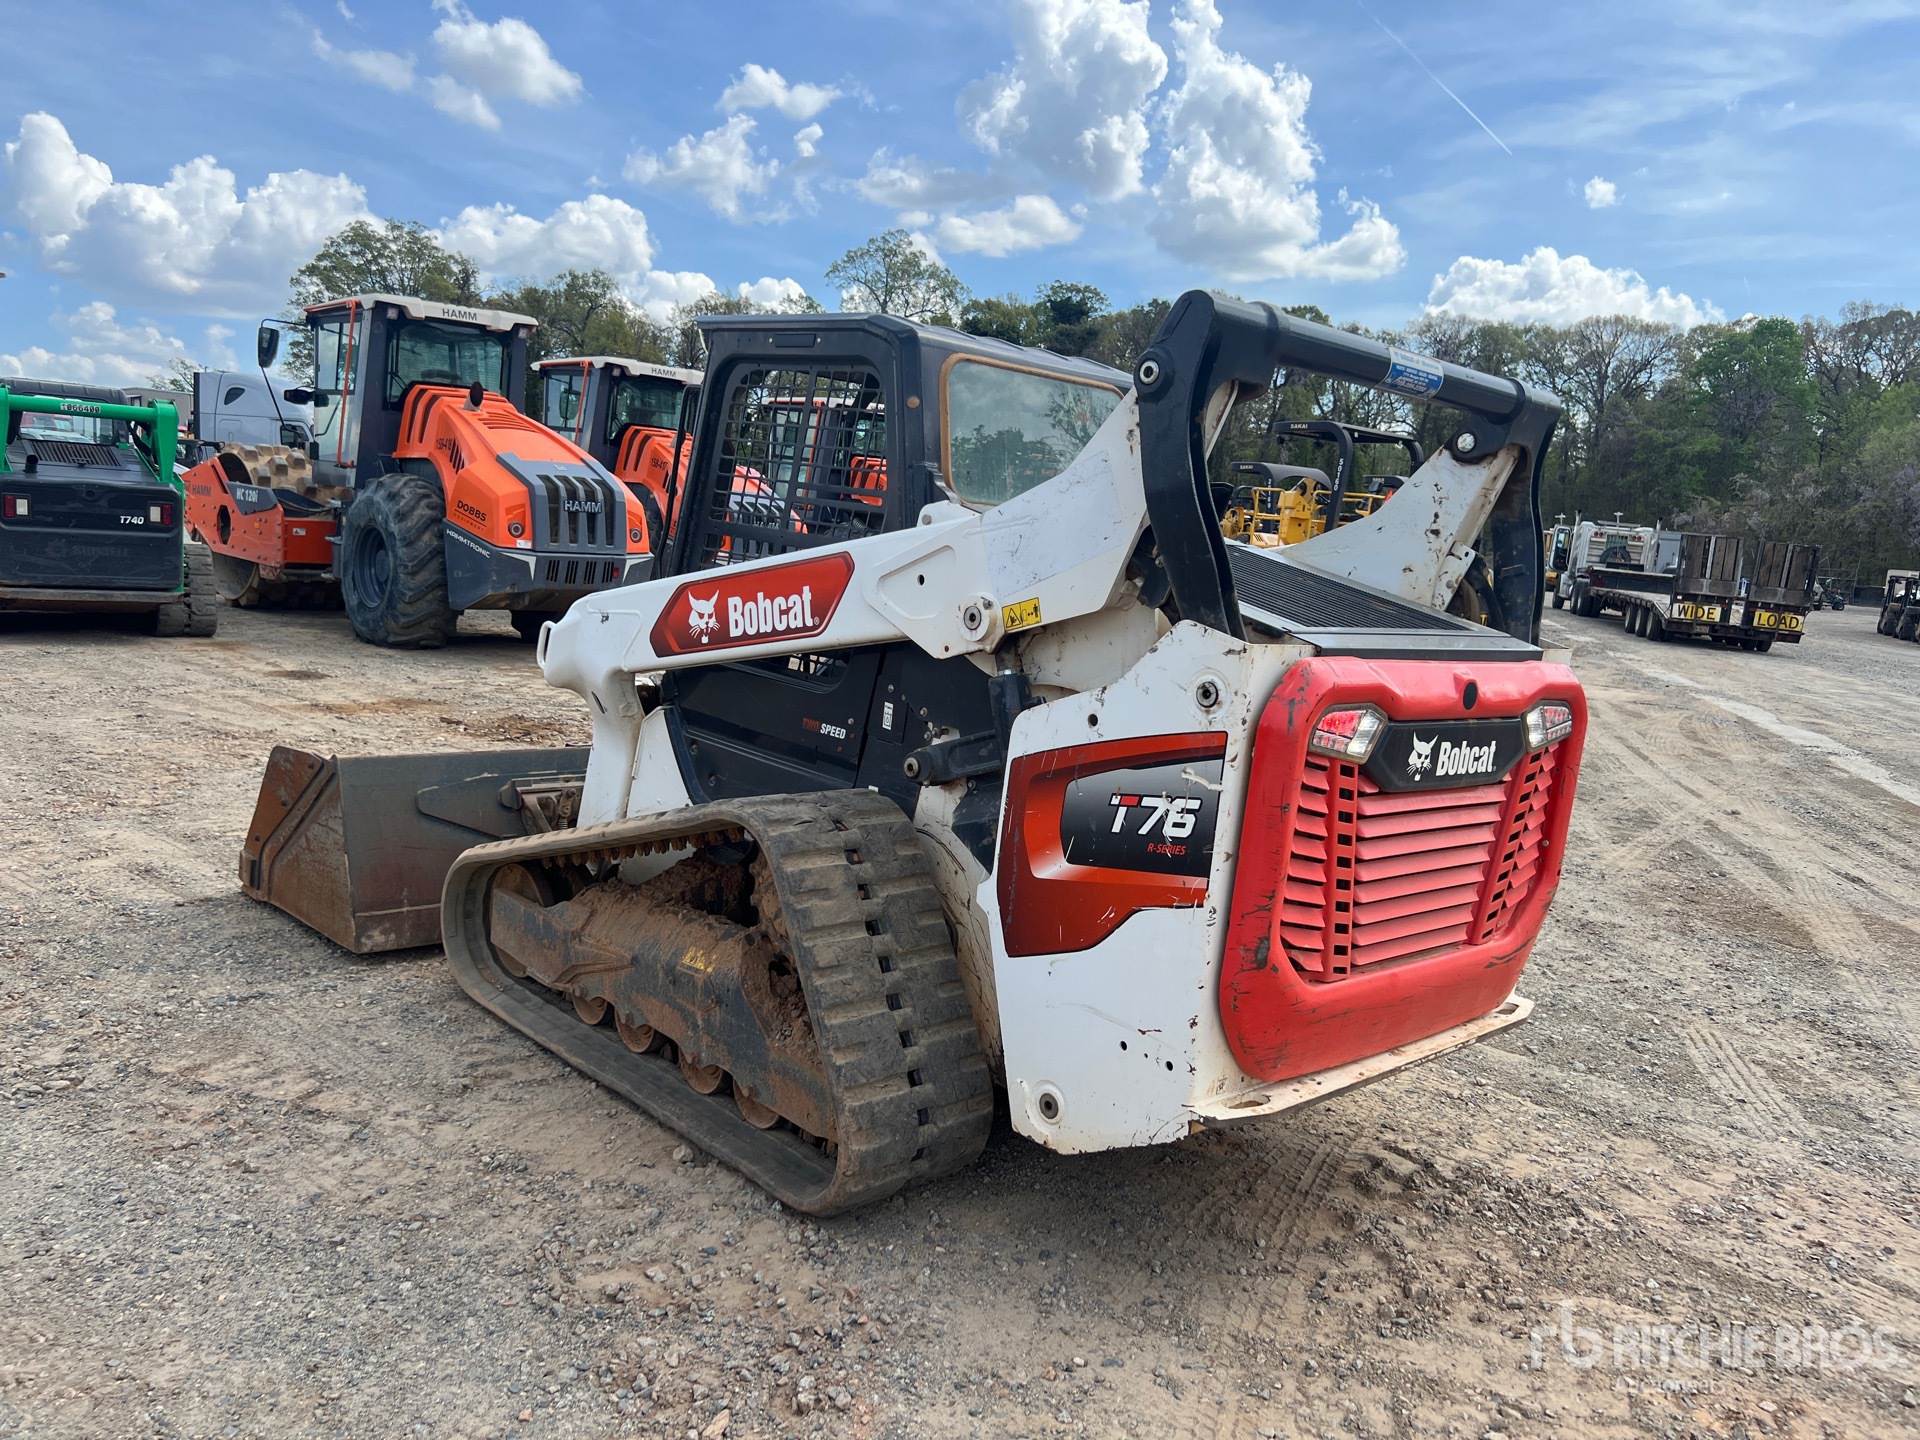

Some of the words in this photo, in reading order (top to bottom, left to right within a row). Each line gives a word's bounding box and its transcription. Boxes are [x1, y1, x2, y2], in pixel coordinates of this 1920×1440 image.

[442, 308, 478, 321] HAMM
[651, 367, 677, 378] HAMM
[191, 484, 212, 497] HAMM
[236, 488, 244, 500] HC
[457, 500, 487, 521] DOBBS
[564, 500, 602, 513] HAMM
[119, 515, 145, 525] T740
[446, 528, 491, 559] HAMMTRONIC
[727, 585, 814, 638] Bobcat
[1677, 604, 1717, 621] WIDE
[1757, 612, 1800, 629] LOAD
[820, 723, 847, 739] SPEED
[1435, 740, 1497, 777] Bobcat
[1110, 794, 1202, 839] T76
[1147, 842, 1187, 856] R-SERIES
